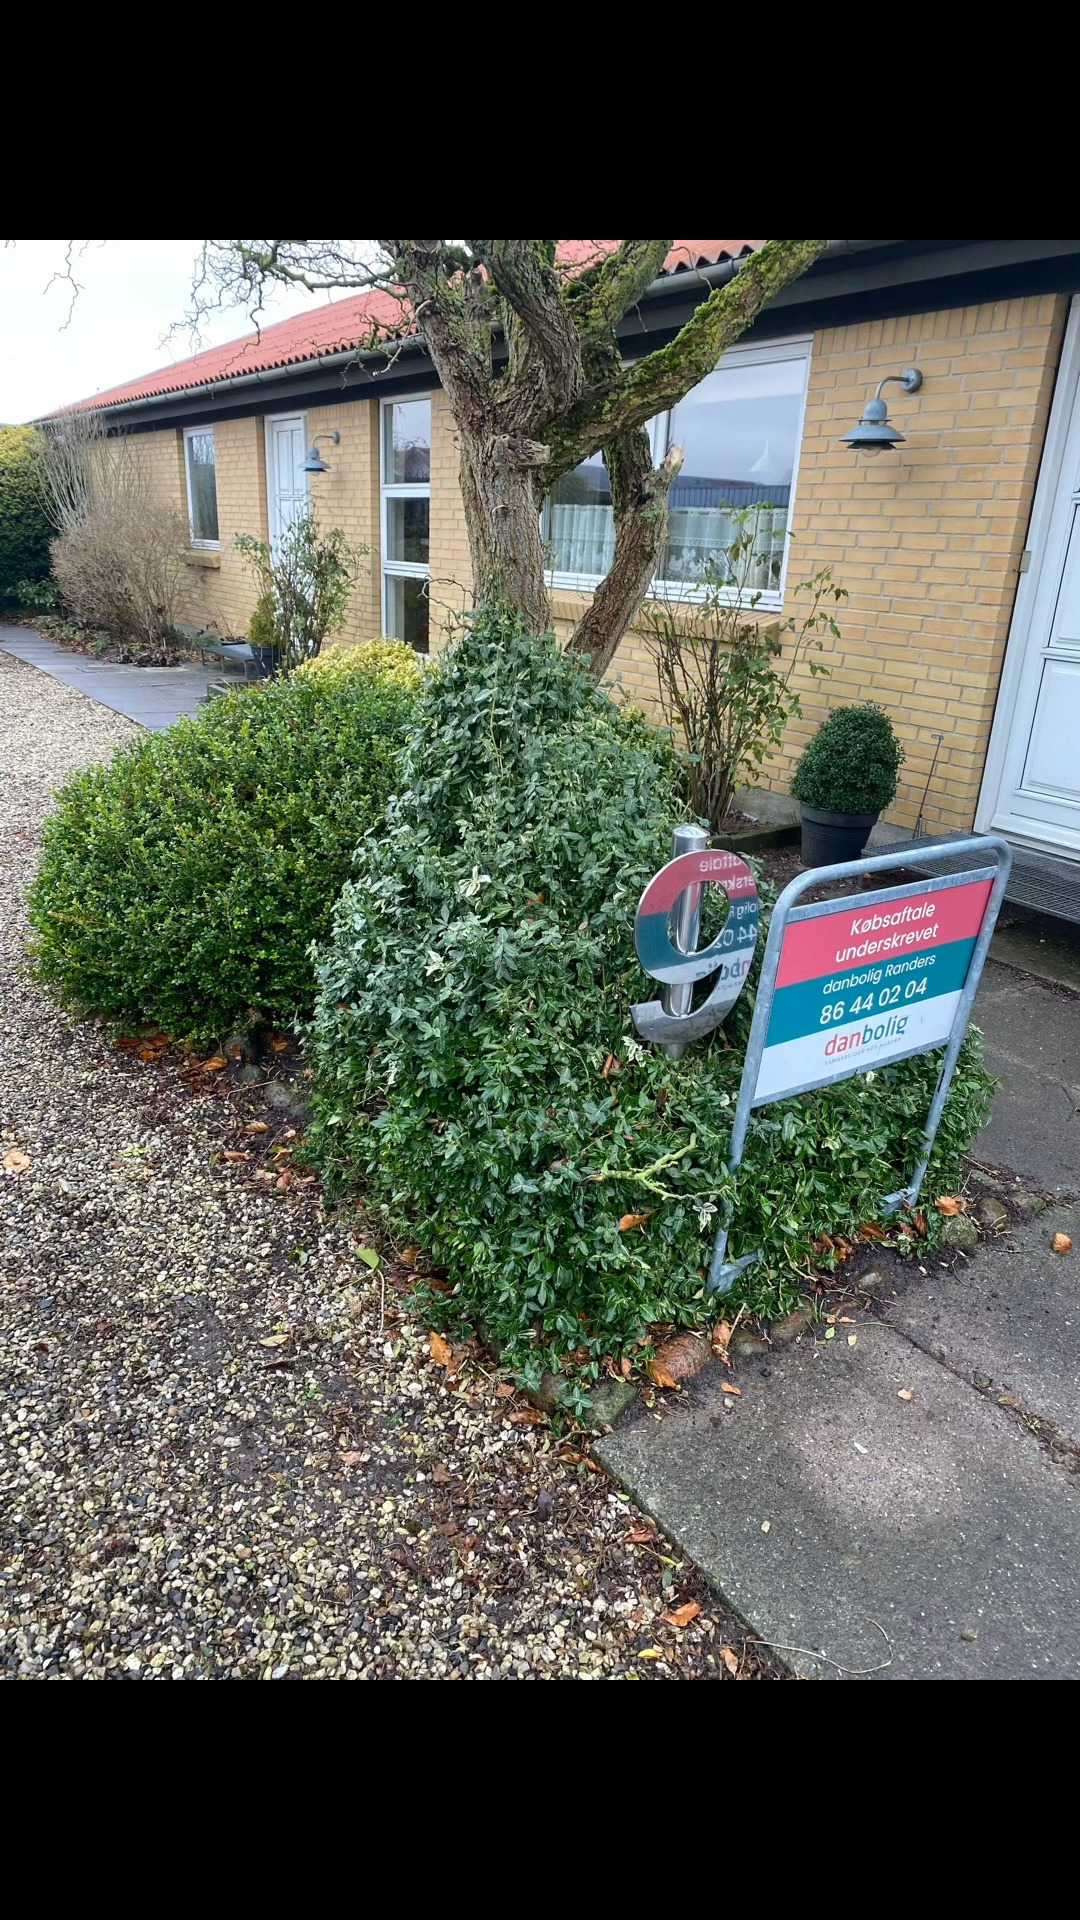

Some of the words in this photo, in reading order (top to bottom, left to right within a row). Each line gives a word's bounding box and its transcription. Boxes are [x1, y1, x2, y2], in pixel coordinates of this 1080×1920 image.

[850, 902, 936, 936] Købsaftale
[629, 848, 759, 1045] 9
[835, 923, 939, 963] underskrevet
[822, 968, 882, 995] danbolig
[885, 954, 936, 978] Randers
[821, 1001, 845, 1025] 86
[849, 992, 874, 1014] 44
[878, 985, 901, 1007] 02
[904, 977, 928, 999] 04
[824, 1015, 910, 1056] danbolig
